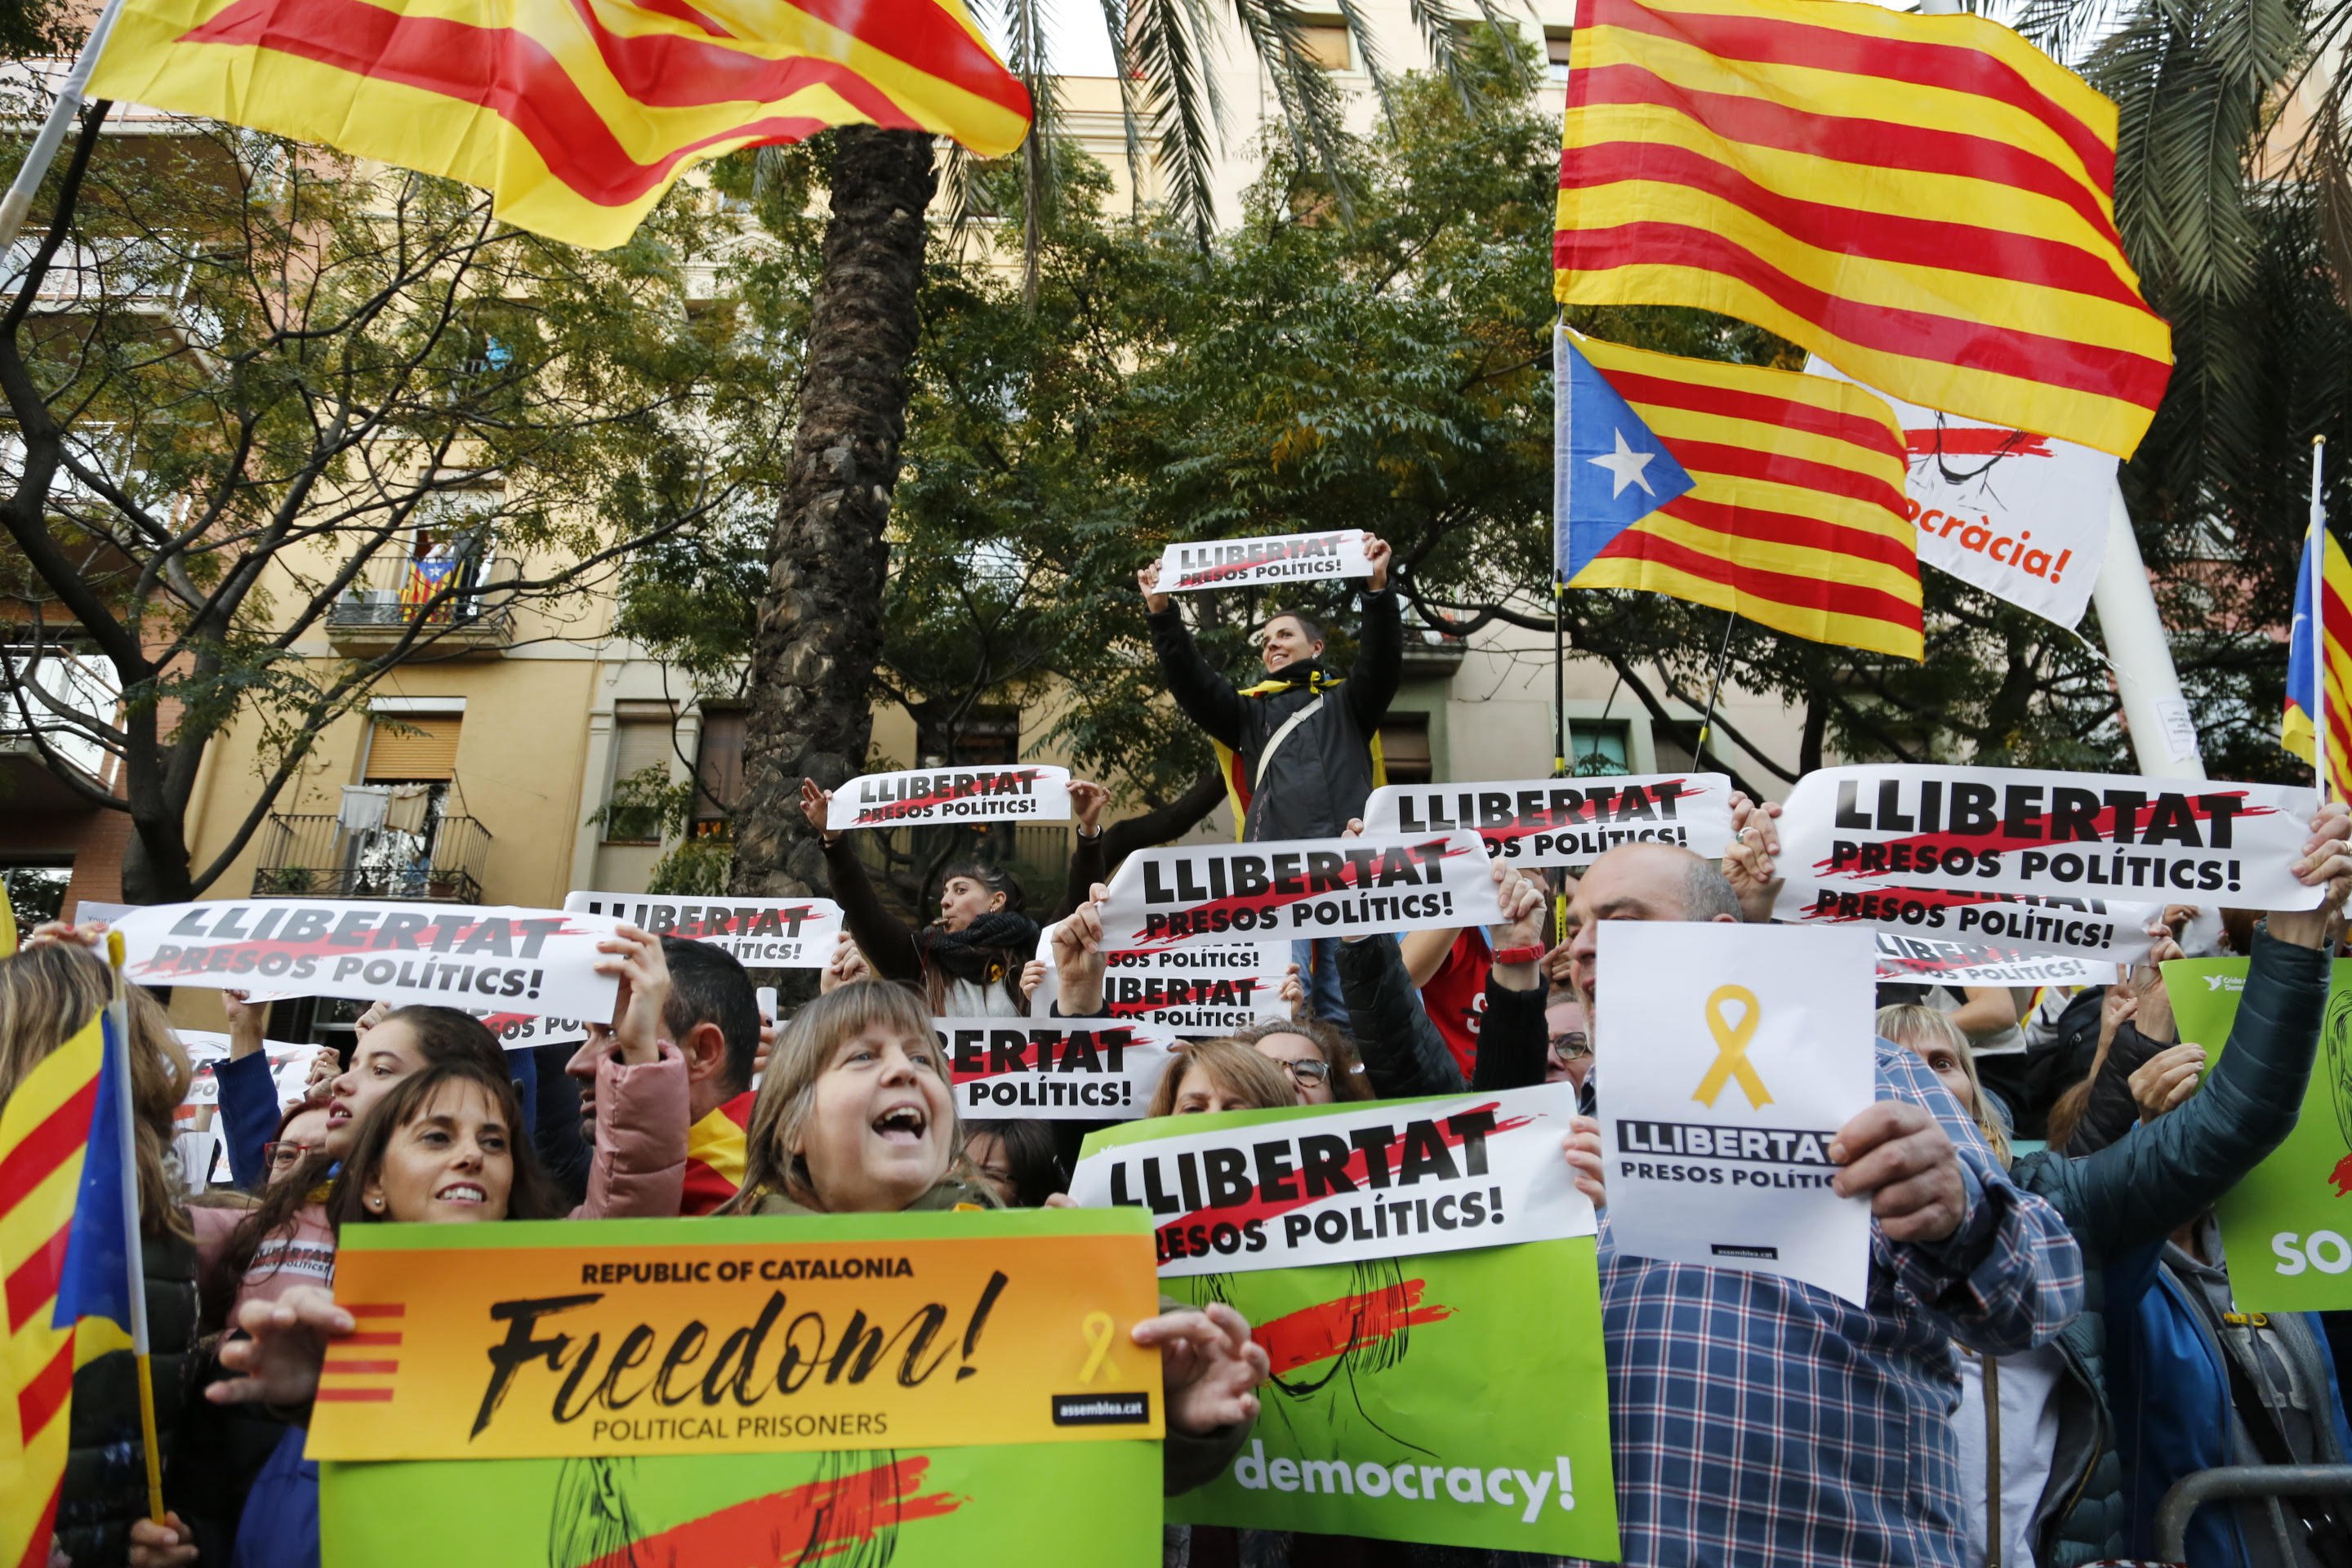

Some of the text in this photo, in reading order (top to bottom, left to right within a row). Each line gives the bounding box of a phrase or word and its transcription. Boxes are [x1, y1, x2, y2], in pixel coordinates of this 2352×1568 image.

[1181, 535, 1343, 569] LLIBERTAT
[1905, 497, 2072, 584] ocràcia!
[1180, 559, 1342, 586] PRESOS POLÍTICS!
[860, 770, 1037, 803] LLIBERTAT
[1399, 782, 1683, 833] LLIBERTAT
[859, 799, 1036, 822] PRESOS POLÍTICS!
[1834, 778, 2243, 850] LLIBERTAT
[1143, 844, 1447, 904] LLIBERTAT
[1832, 840, 2241, 892] PRESOS POLÍTICS!
[168, 907, 564, 960] LLIBERTAT
[1146, 892, 1454, 937] PRESOS POLÍTICS!
[1816, 889, 1947, 928] PRESOS
[1959, 908, 2114, 949] POLÍTICS!
[149, 944, 543, 1000] PRESOS POLÍTICS!
[1109, 949, 1259, 968] SOS POLÍTICS!
[1105, 977, 1256, 1007] IBERTAT
[936, 1029, 1132, 1073] ERTAT
[969, 1075, 1131, 1107] POLÍTICS!
[1111, 1111, 1497, 1215] LLIBERTAT
[1621, 1162, 1836, 1189] PRESOS POLÍTIC
[1156, 1186, 1503, 1261] RESOS POLÍTICS!
[581, 1258, 914, 1285] REPUBLIC OF CATALONIA
[468, 1270, 1009, 1444] Freedom!
[594, 1414, 888, 1441] POLITICAL PRISONERS
[1060, 1401, 1143, 1417] assemblea.cat
[1234, 1438, 1575, 1523] democracy!
